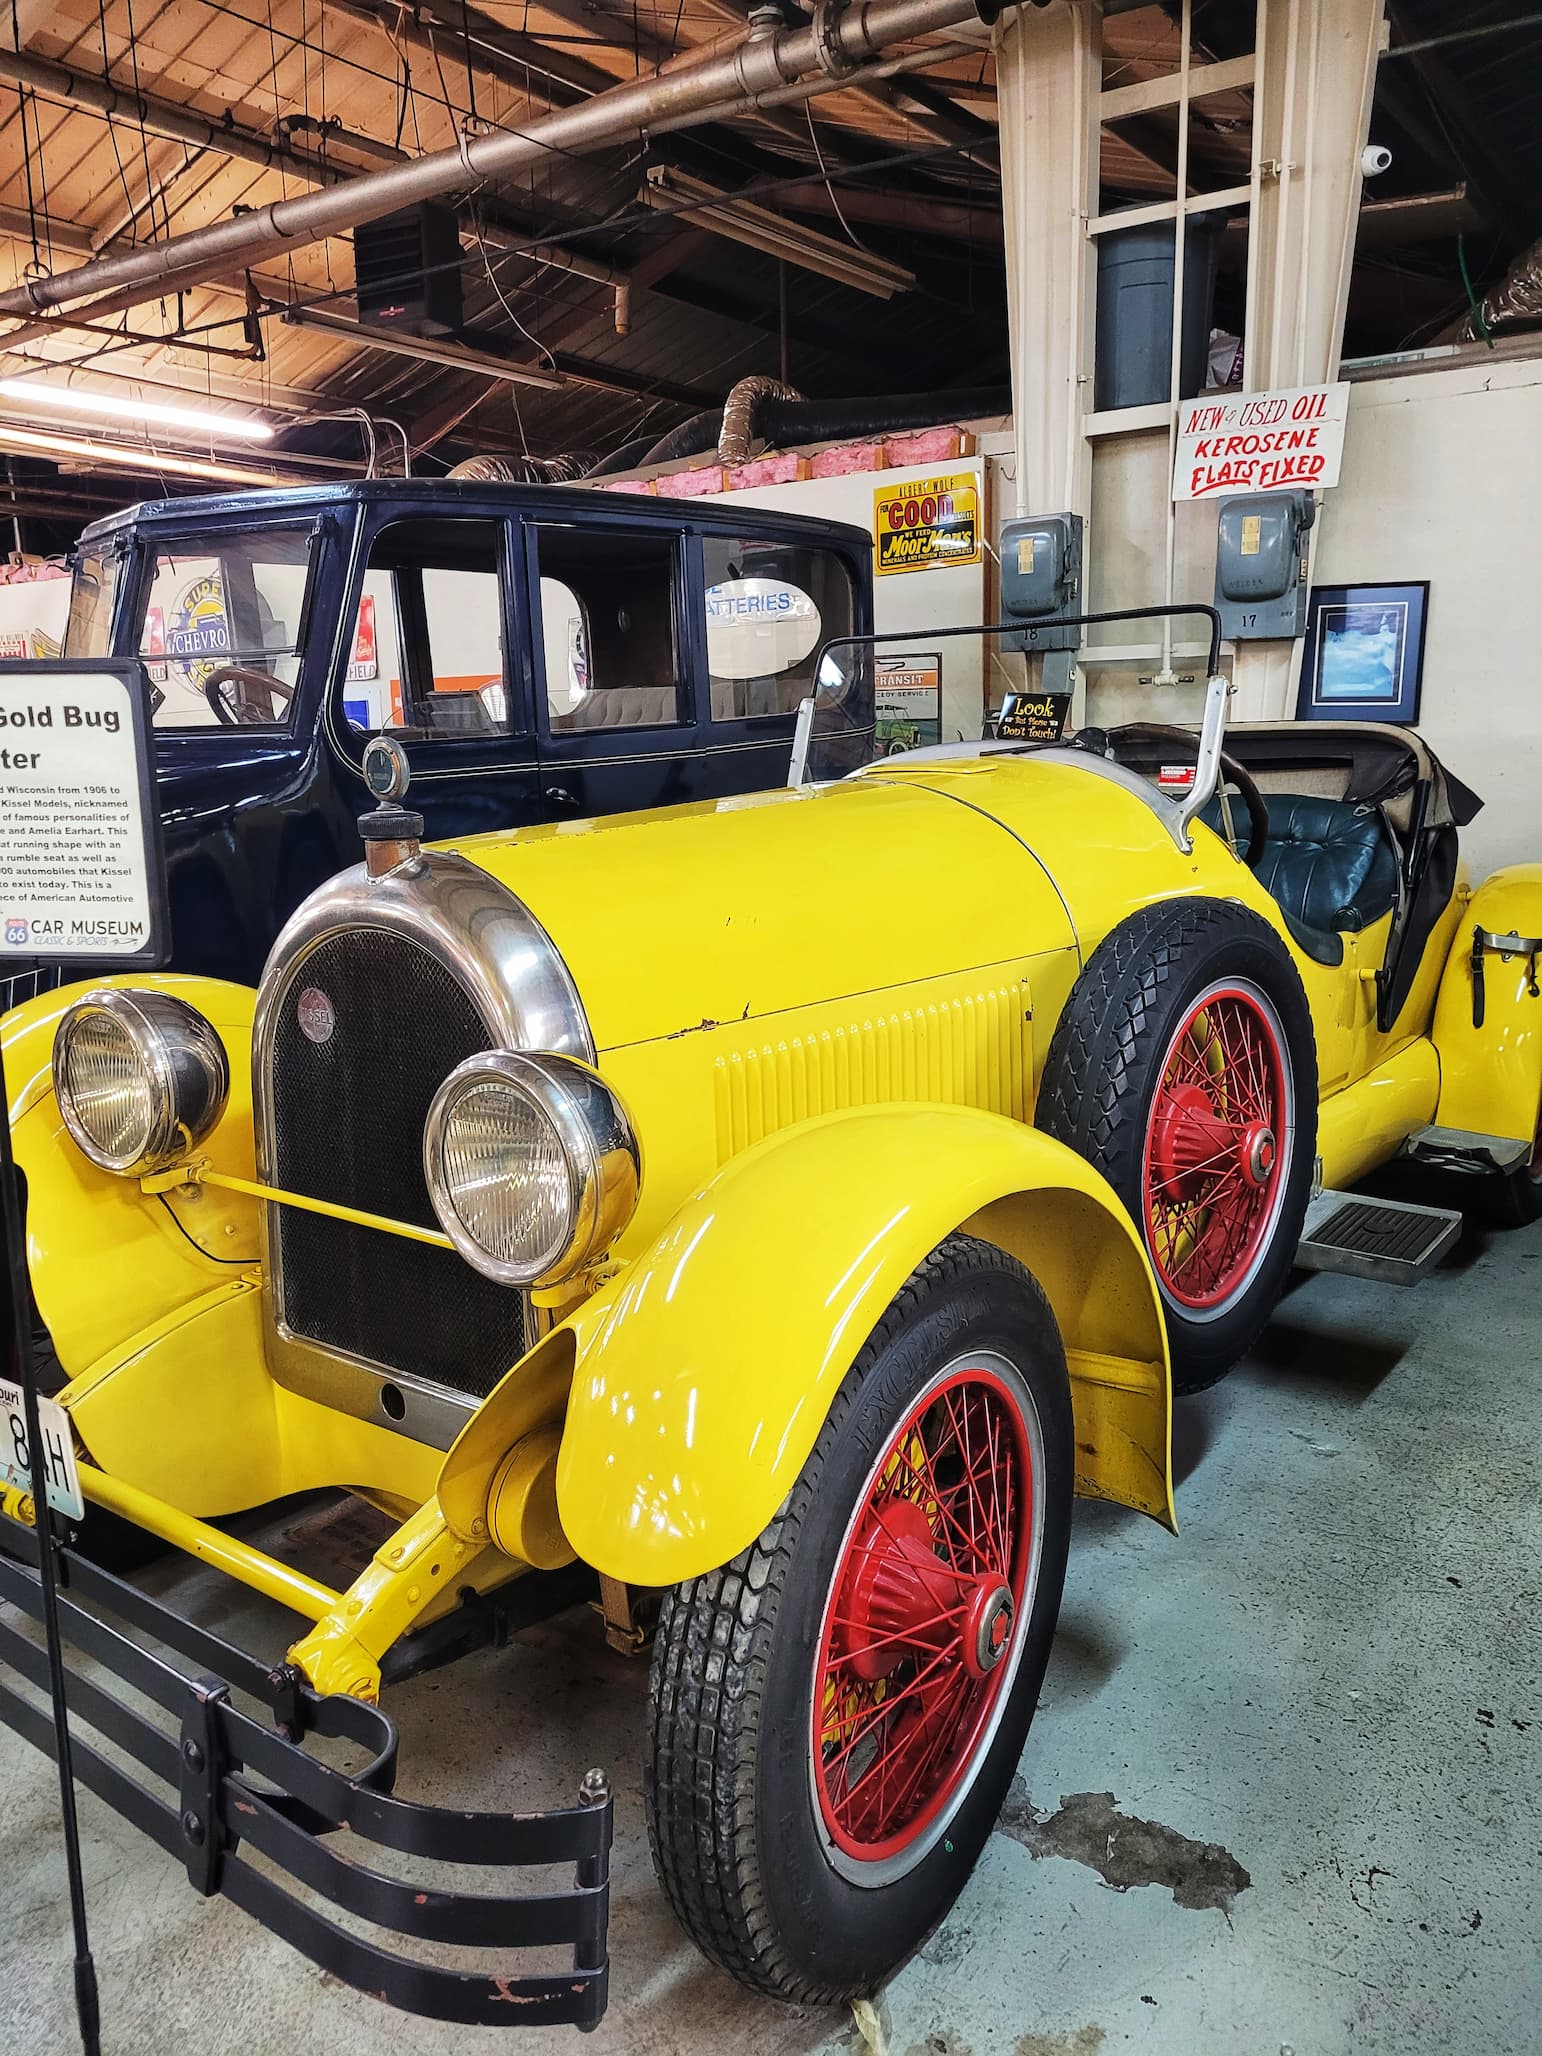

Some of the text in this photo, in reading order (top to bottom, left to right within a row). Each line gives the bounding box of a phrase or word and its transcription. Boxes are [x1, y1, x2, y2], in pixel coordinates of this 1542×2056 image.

[1185, 405, 1227, 434] NEW
[1239, 399, 1288, 427] USED
[1291, 393, 1328, 421] OIL
[1194, 427, 1320, 459] KEROSENE
[1191, 455, 1325, 491] FLATS FIXED
[899, 478, 954, 497] ALBERT WOLF
[888, 494, 954, 530] GOOD
[915, 529, 931, 537] FEED
[1242, 614, 1257, 628] 17
[175, 628, 226, 654] CHEVRO
[1024, 628, 1038, 640] 18
[1014, 696, 1055, 717] Look
[63, 705, 121, 733] Bug
[1002, 725, 1057, 739] Don't Touch!
[0, 748, 41, 769] ter
[7, 786, 56, 794] Wisconsin
[58, 786, 81, 794] from
[84, 786, 107, 794] 1906
[1, 800, 128, 809] Kissel Models, nicknamed
[2, 813, 130, 823] of famous personalities of
[8, 827, 26, 835] and
[29, 827, 62, 835] Amelia
[65, 827, 104, 835] Earhart.
[107, 827, 128, 835] This
[13, 841, 49, 850] running
[52, 841, 82, 850] shape
[85, 841, 106, 849] with
[7, 854, 40, 862] rumble
[81, 854, 102, 862] well
[16, 867, 76, 875] automobiles
[101, 868, 132, 876] Kissel
[0, 880, 9, 888] to
[11, 880, 35, 888] exist
[38, 880, 69, 890] today.
[95, 881, 104, 889] is
[18, 893, 28, 902] of
[30, 893, 76, 902] American
[79, 894, 134, 903] Automotive
[8, 928, 26, 942] 66
[31, 920, 64, 934] CAR
[71, 920, 144, 935] MUSEUM
[34, 935, 65, 945] CLASSIC
[76, 935, 109, 945] SPORTS
[9, 1413, 70, 1493] 8H
